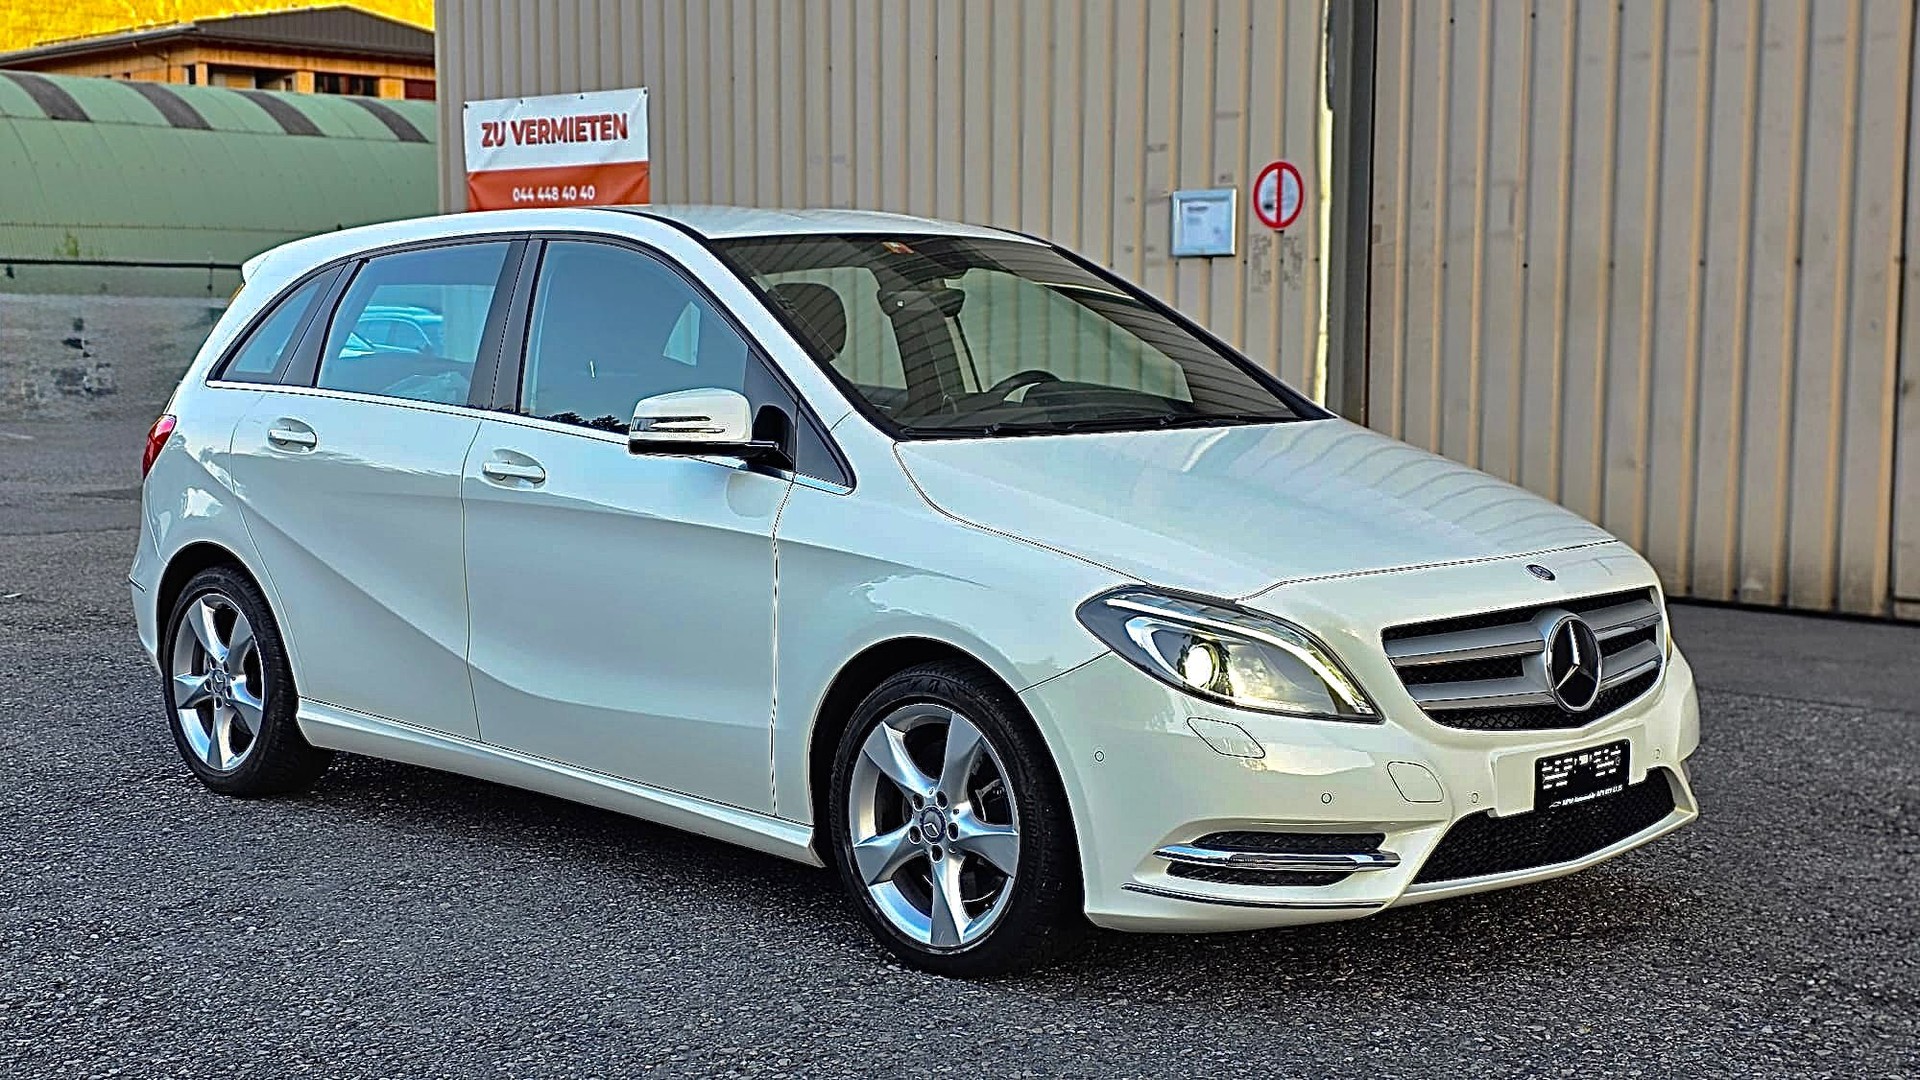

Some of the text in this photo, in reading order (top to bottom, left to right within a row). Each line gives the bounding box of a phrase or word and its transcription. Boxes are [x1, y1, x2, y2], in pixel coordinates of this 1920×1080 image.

[481, 113, 628, 147] ZU VERMIETEN
[512, 185, 595, 202] 044 448 40 40
